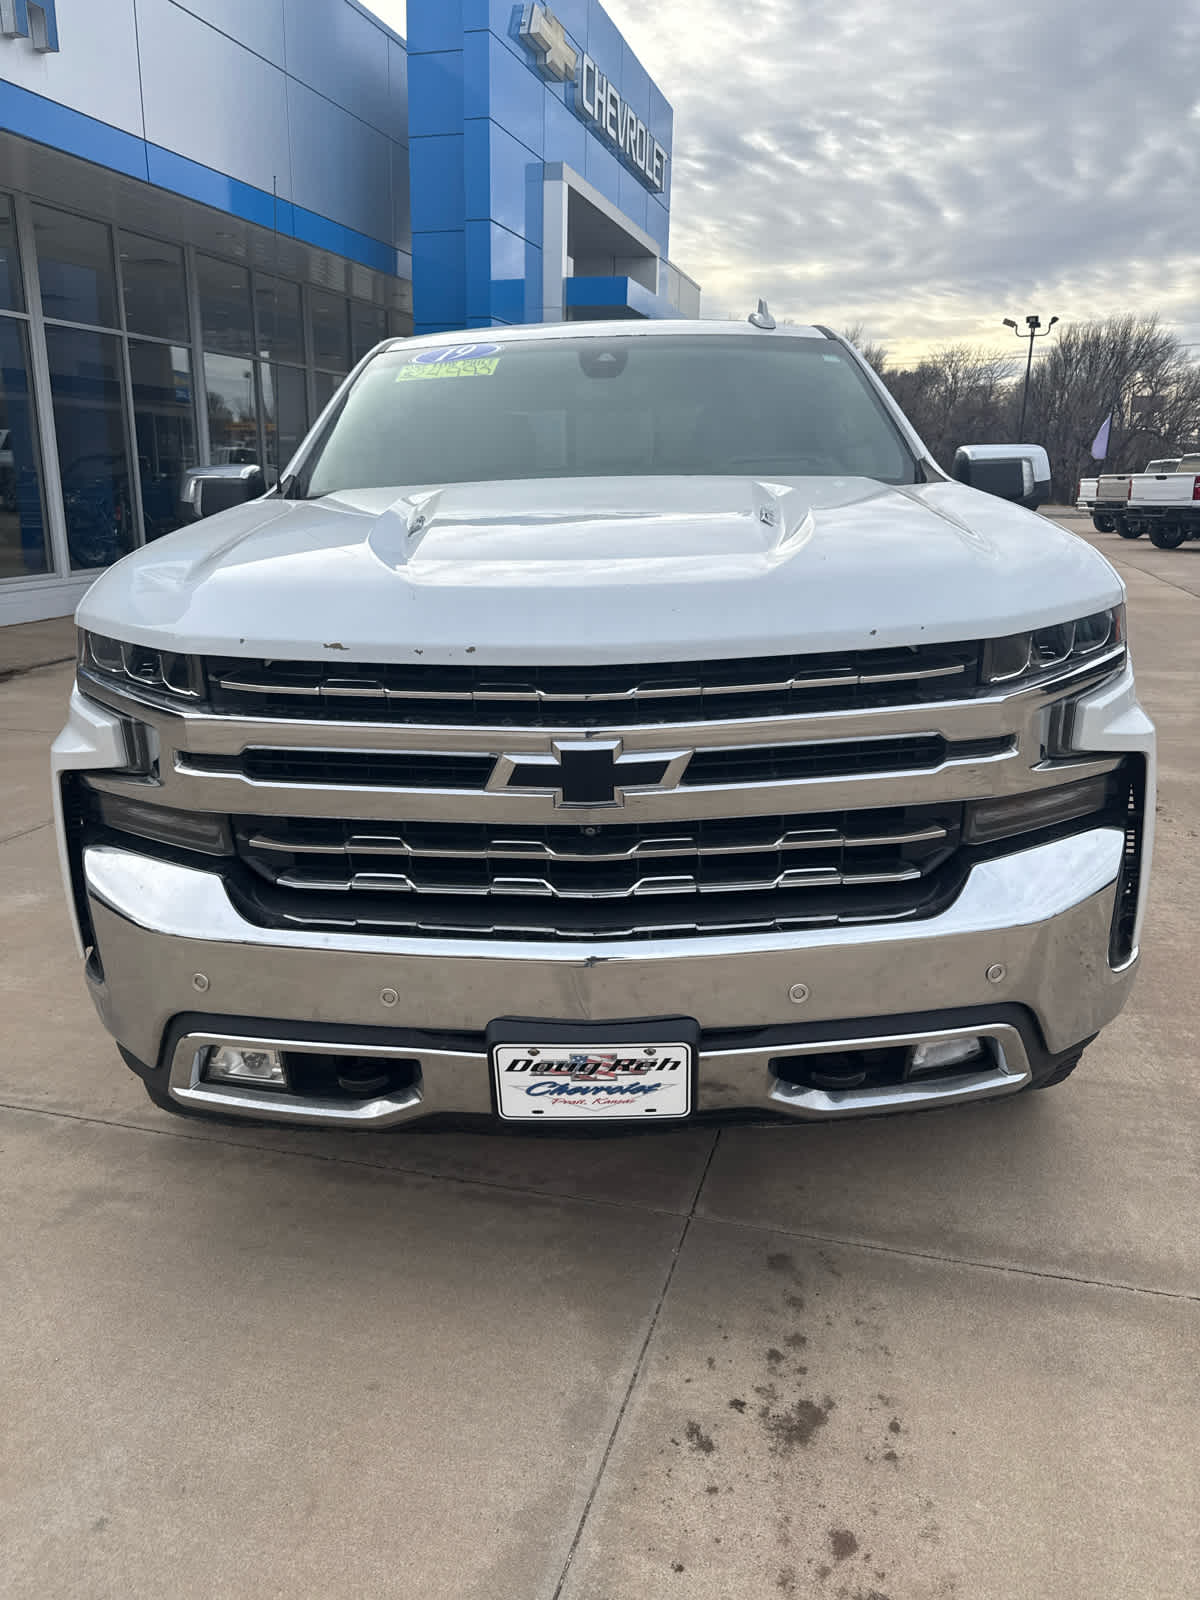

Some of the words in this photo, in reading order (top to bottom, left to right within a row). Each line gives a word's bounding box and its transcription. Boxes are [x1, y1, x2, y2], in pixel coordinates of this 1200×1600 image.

[582, 52, 668, 192] CHEVROLET
[505, 1058, 602, 1076] Doug
[609, 1057, 682, 1072] Reh
[525, 1081, 662, 1097] Chevrolet
